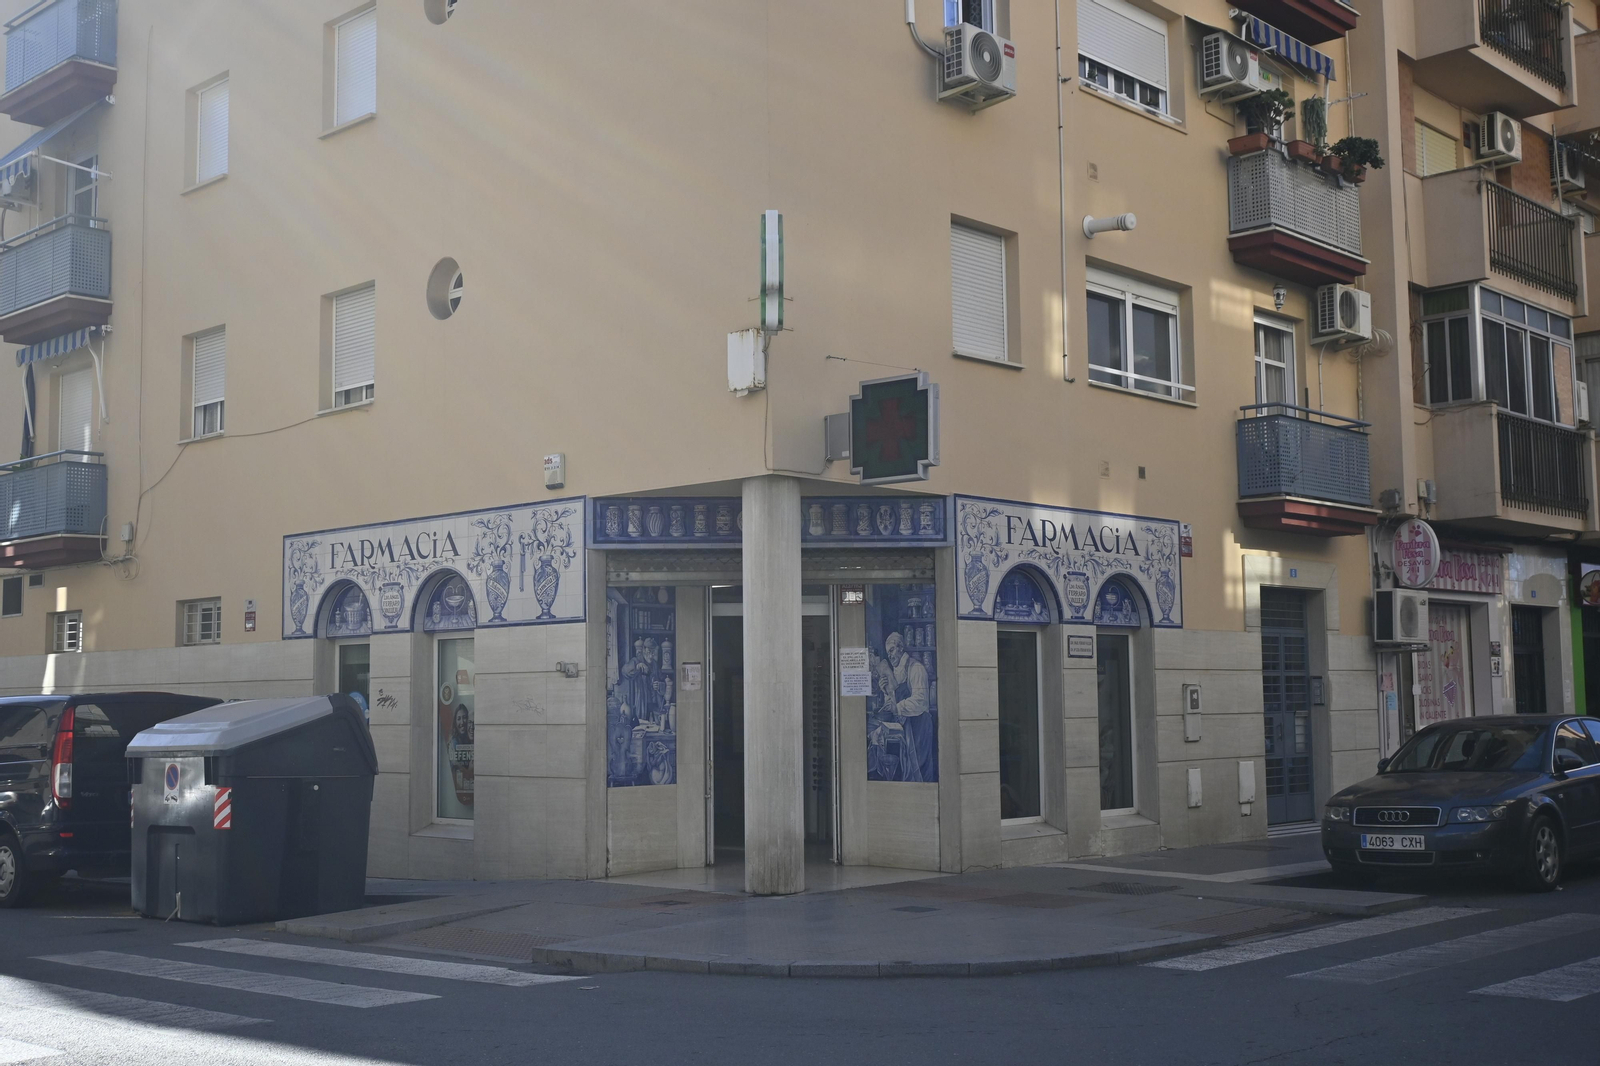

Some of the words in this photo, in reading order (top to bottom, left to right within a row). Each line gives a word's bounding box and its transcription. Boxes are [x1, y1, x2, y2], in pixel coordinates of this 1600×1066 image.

[1395, 539, 1431, 551] Pantera
[1402, 550, 1424, 560] Rosa
[1397, 559, 1431, 567] DESAVIO
[1478, 555, 1499, 568] DESAVIO
[1453, 554, 1477, 582] Rosa
[1418, 660, 1432, 669] BIDAS
[1418, 673, 1433, 682] SAVIO
[1425, 710, 1447, 720] CALIENTE
[1369, 837, 1394, 848] 4063
[1401, 837, 1422, 848] CXH
